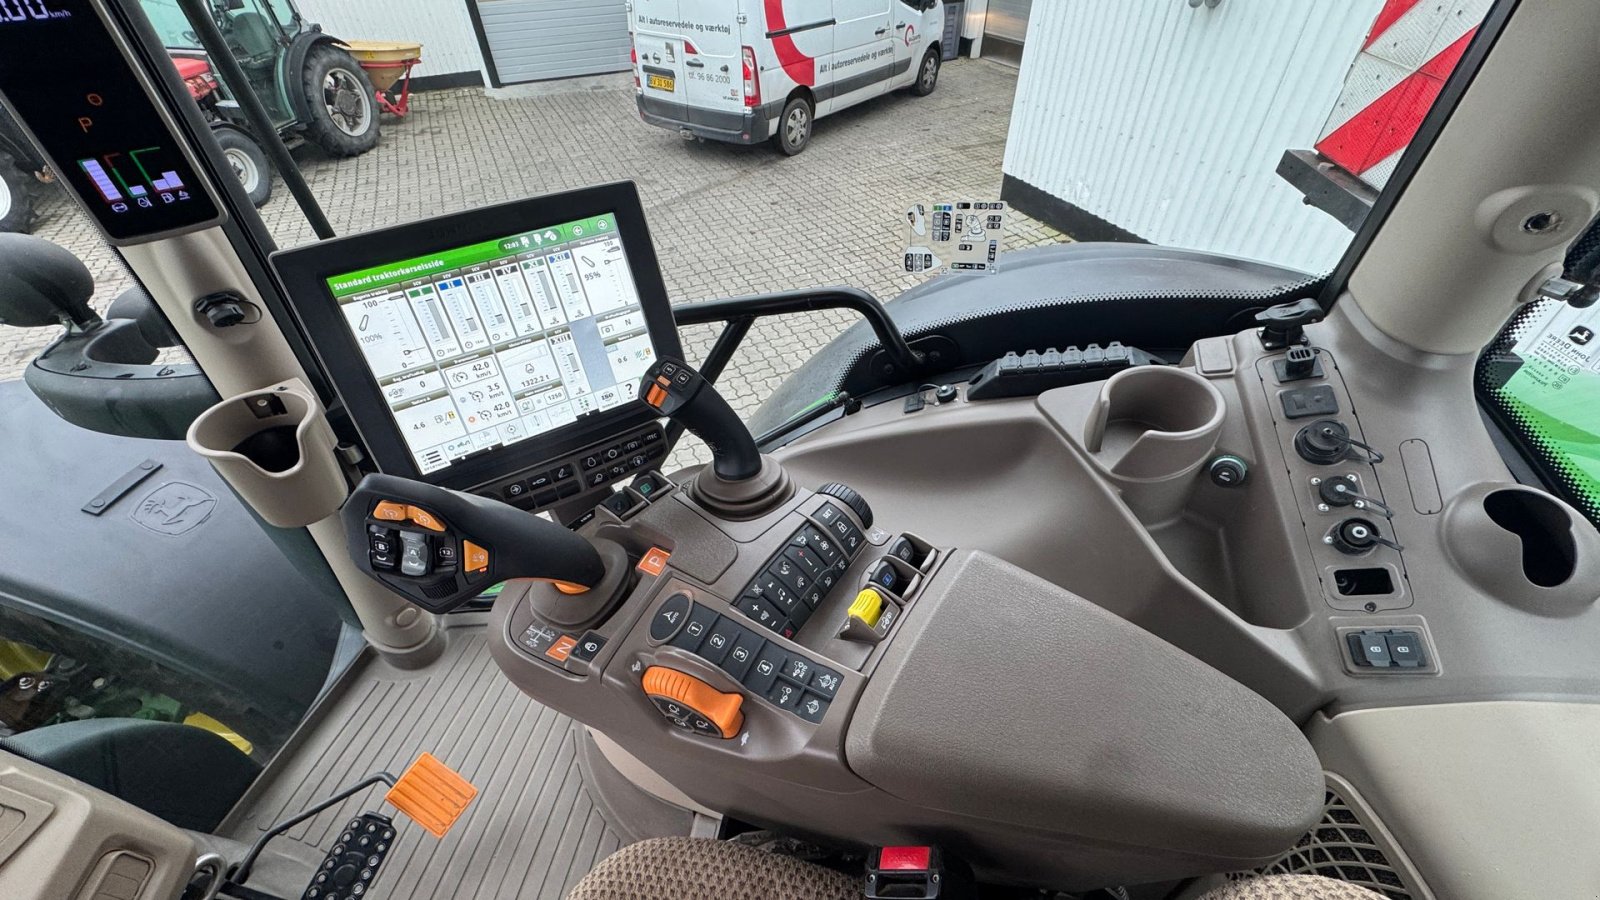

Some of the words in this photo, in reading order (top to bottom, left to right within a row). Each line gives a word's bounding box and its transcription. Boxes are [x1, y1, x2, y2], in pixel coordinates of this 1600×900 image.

[0, 0, 49, 22] .00
[48, 10, 71, 18] km/h
[696, 23, 704, 32] og
[705, 24, 731, 35] værktøj
[871, 51, 877, 59] og
[716, 74, 731, 84] 2000
[584, 270, 601, 281] 95%
[333, 275, 372, 291] Standard
[362, 299, 378, 309] 100
[624, 318, 631, 326] N
[359, 332, 383, 344] 100%
[471, 360, 490, 372] 42.0
[475, 369, 492, 379] km/t
[418, 380, 426, 388] 0
[520, 375, 544, 387] 1322.2
[487, 382, 500, 392] 3.5
[488, 389, 504, 399] km/t
[492, 401, 510, 412] 42.0
[496, 408, 512, 418] km/t
[412, 421, 426, 430] 4.6
[822, 508, 833, 519] SET
[648, 554, 661, 567] P
[670, 611, 680, 624] AUTO
[556, 641, 572, 654] N
[799, 665, 808, 679] AUTO
[829, 677, 838, 691] AUTO
